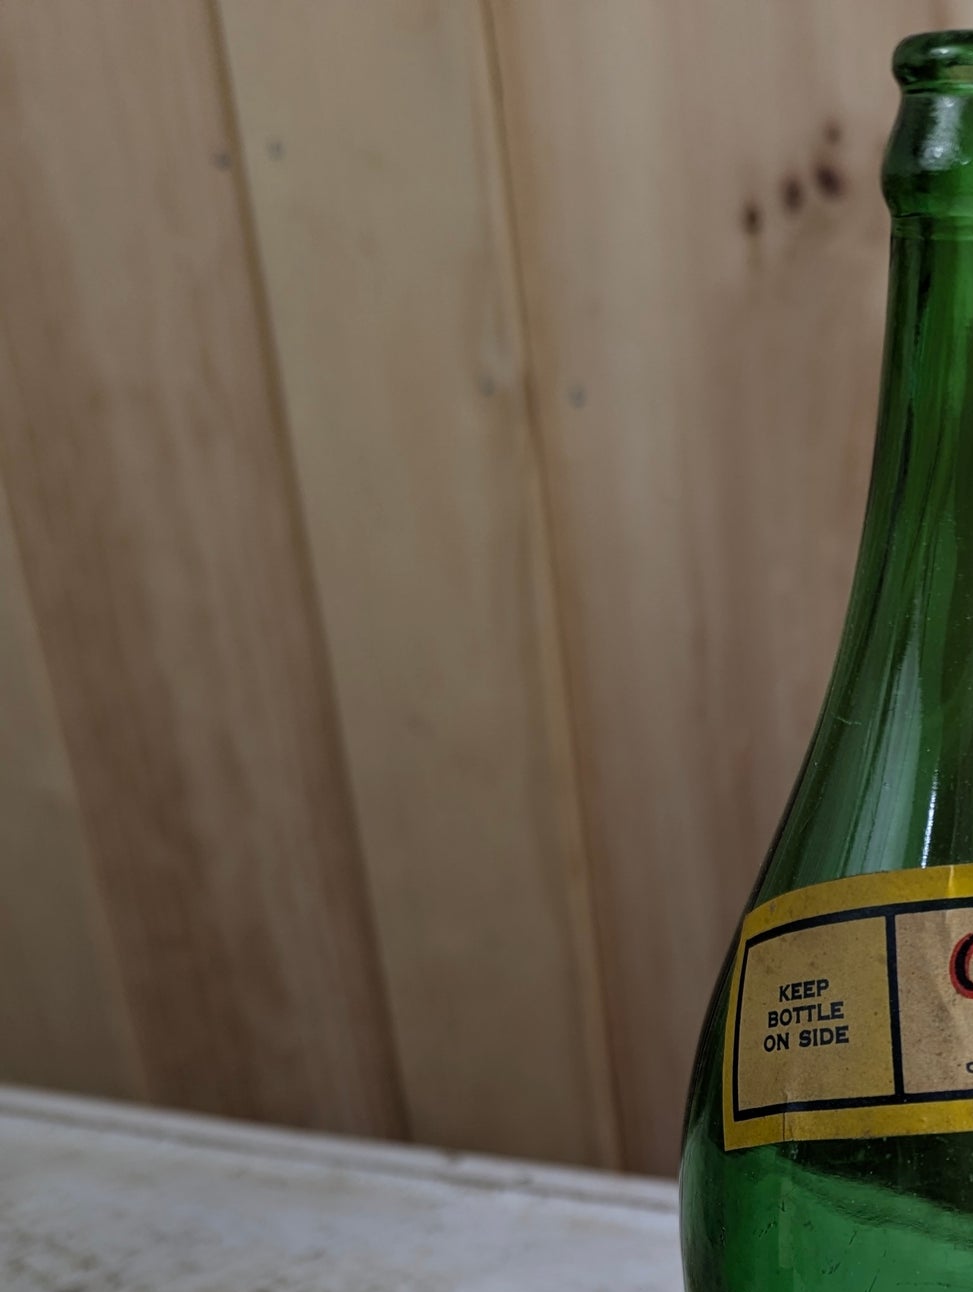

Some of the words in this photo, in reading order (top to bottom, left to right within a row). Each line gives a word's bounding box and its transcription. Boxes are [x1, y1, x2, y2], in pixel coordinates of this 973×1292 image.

[778, 979, 829, 1002] KEEP
[767, 1001, 844, 1028] BOTTLE
[763, 1032, 789, 1052] ON
[799, 1025, 849, 1047] SIDE
